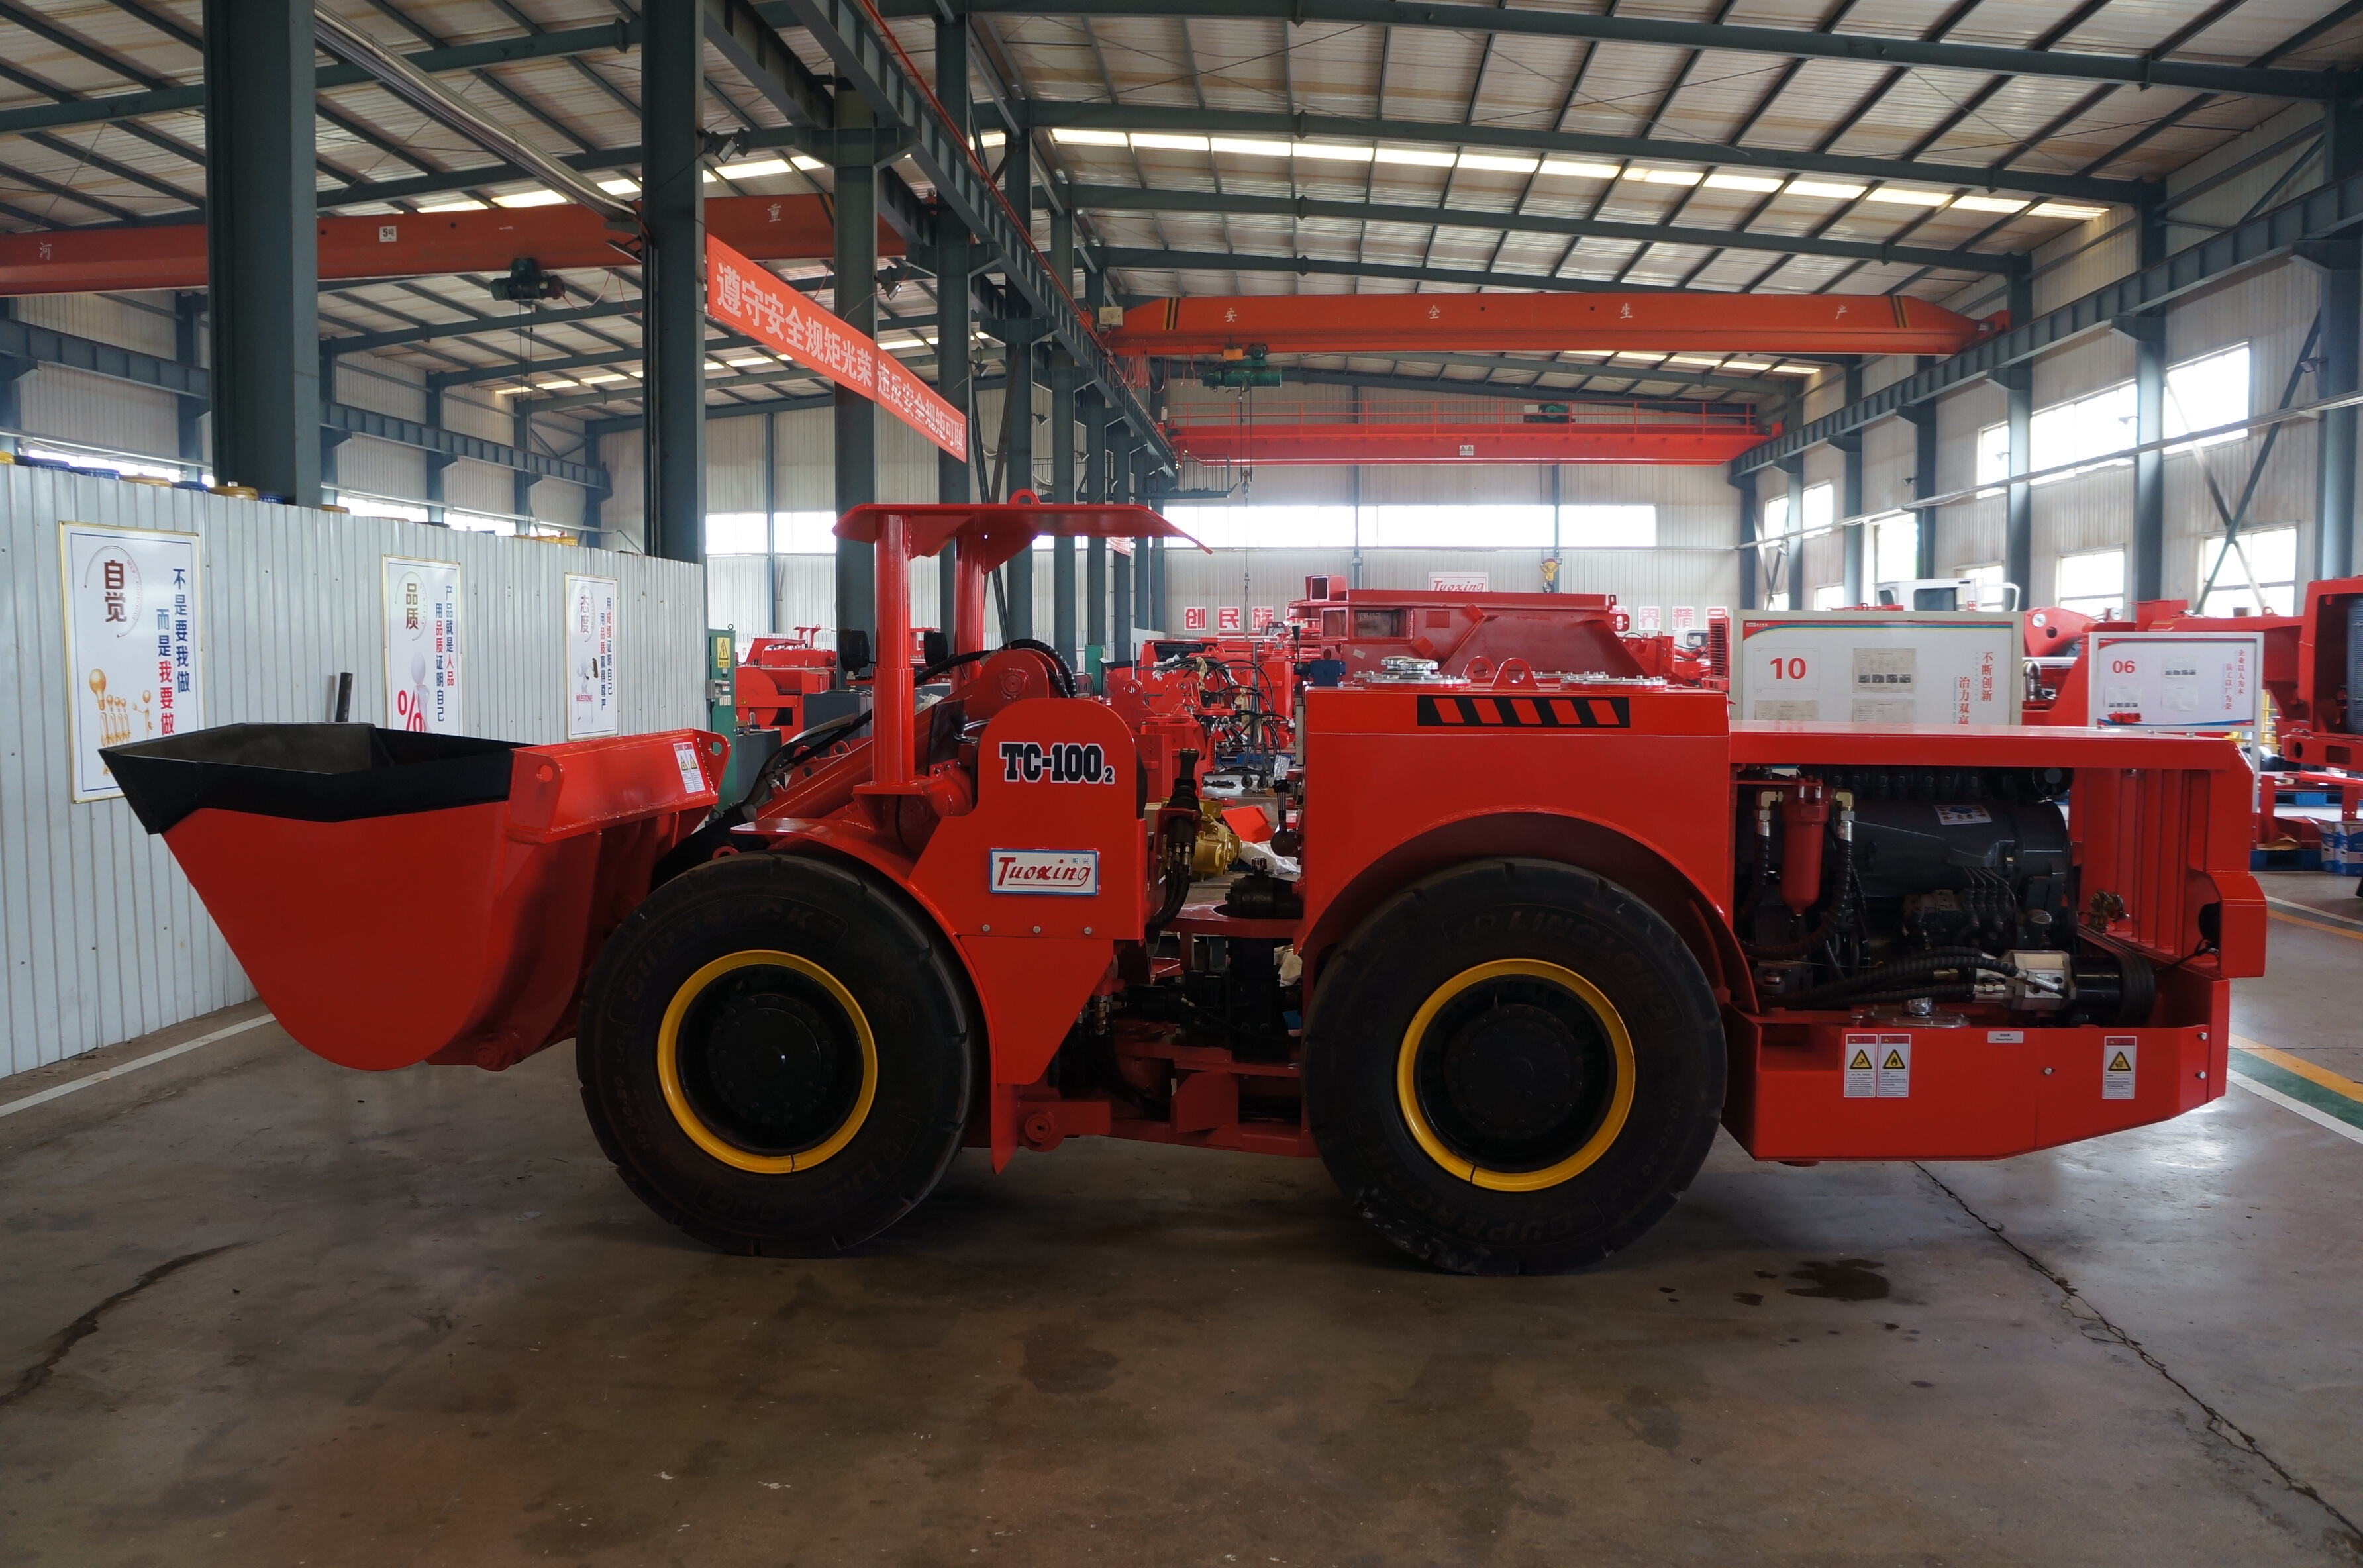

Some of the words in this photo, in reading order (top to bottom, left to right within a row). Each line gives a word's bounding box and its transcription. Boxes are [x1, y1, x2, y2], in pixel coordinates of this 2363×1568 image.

[767, 203, 782, 222] 重
[717, 262, 872, 387] 遵守安全规矩光荣
[103, 559, 128, 623] 自觉
[405, 583, 419, 630] 品质
[580, 595, 589, 634] 态度
[173, 568, 191, 693] 不是要我做
[446, 585, 454, 687] 产品就是人品
[156, 609, 174, 736] 而是我要做
[435, 603, 444, 722] 用品质证明自己
[1770, 657, 1807, 680] 10
[1981, 651, 1993, 701] 不断创新
[2112, 660, 2135, 673] 06
[2237, 649, 2246, 695] 企业以人为本
[997, 857, 1091, 887] Tuoxing
